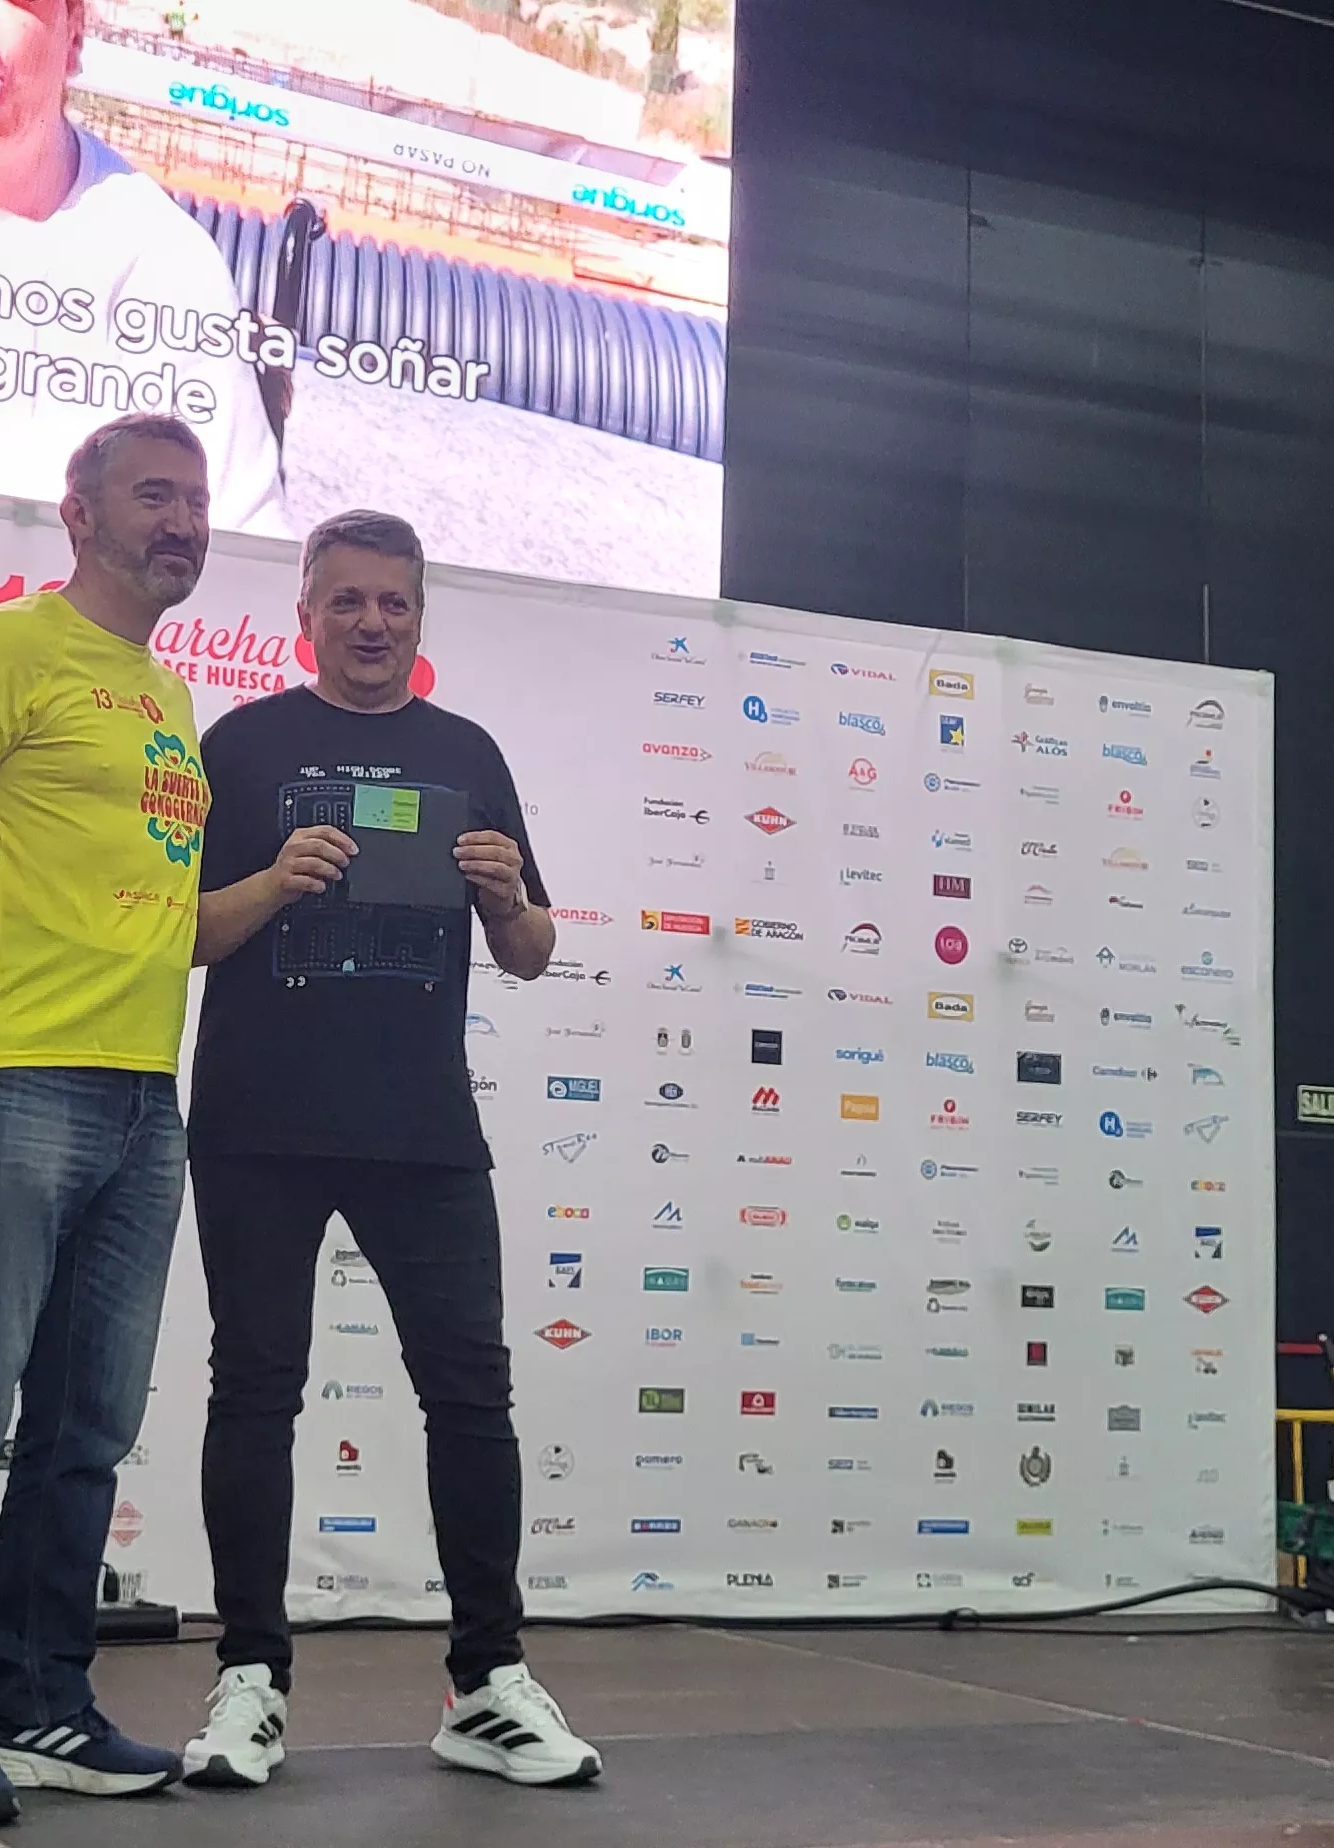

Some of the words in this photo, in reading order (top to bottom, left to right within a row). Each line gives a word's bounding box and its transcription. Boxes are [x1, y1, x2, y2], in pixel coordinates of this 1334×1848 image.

[393, 142, 455, 168] PASAR
[462, 160, 490, 178] NO
[115, 295, 297, 372] gusta
[317, 328, 490, 402] soñar
[155, 613, 291, 667] archa
[207, 663, 286, 692] HUESCA
[851, 668, 896, 681] VIDAL
[937, 679, 968, 691] Bada
[91, 688, 113, 709] 13
[654, 692, 705, 707] SERFEY
[839, 712, 885, 735] blasco
[642, 743, 698, 758] avanza
[145, 766, 158, 792] LA
[162, 770, 201, 800] SUERTE
[754, 814, 787, 827] KUHN
[846, 869, 882, 882] Levitec
[550, 908, 598, 922] vanza
[544, 970, 585, 981] berCaja
[544, 1327, 582, 1340] KUHN
[646, 1328, 683, 1342] IBOR
